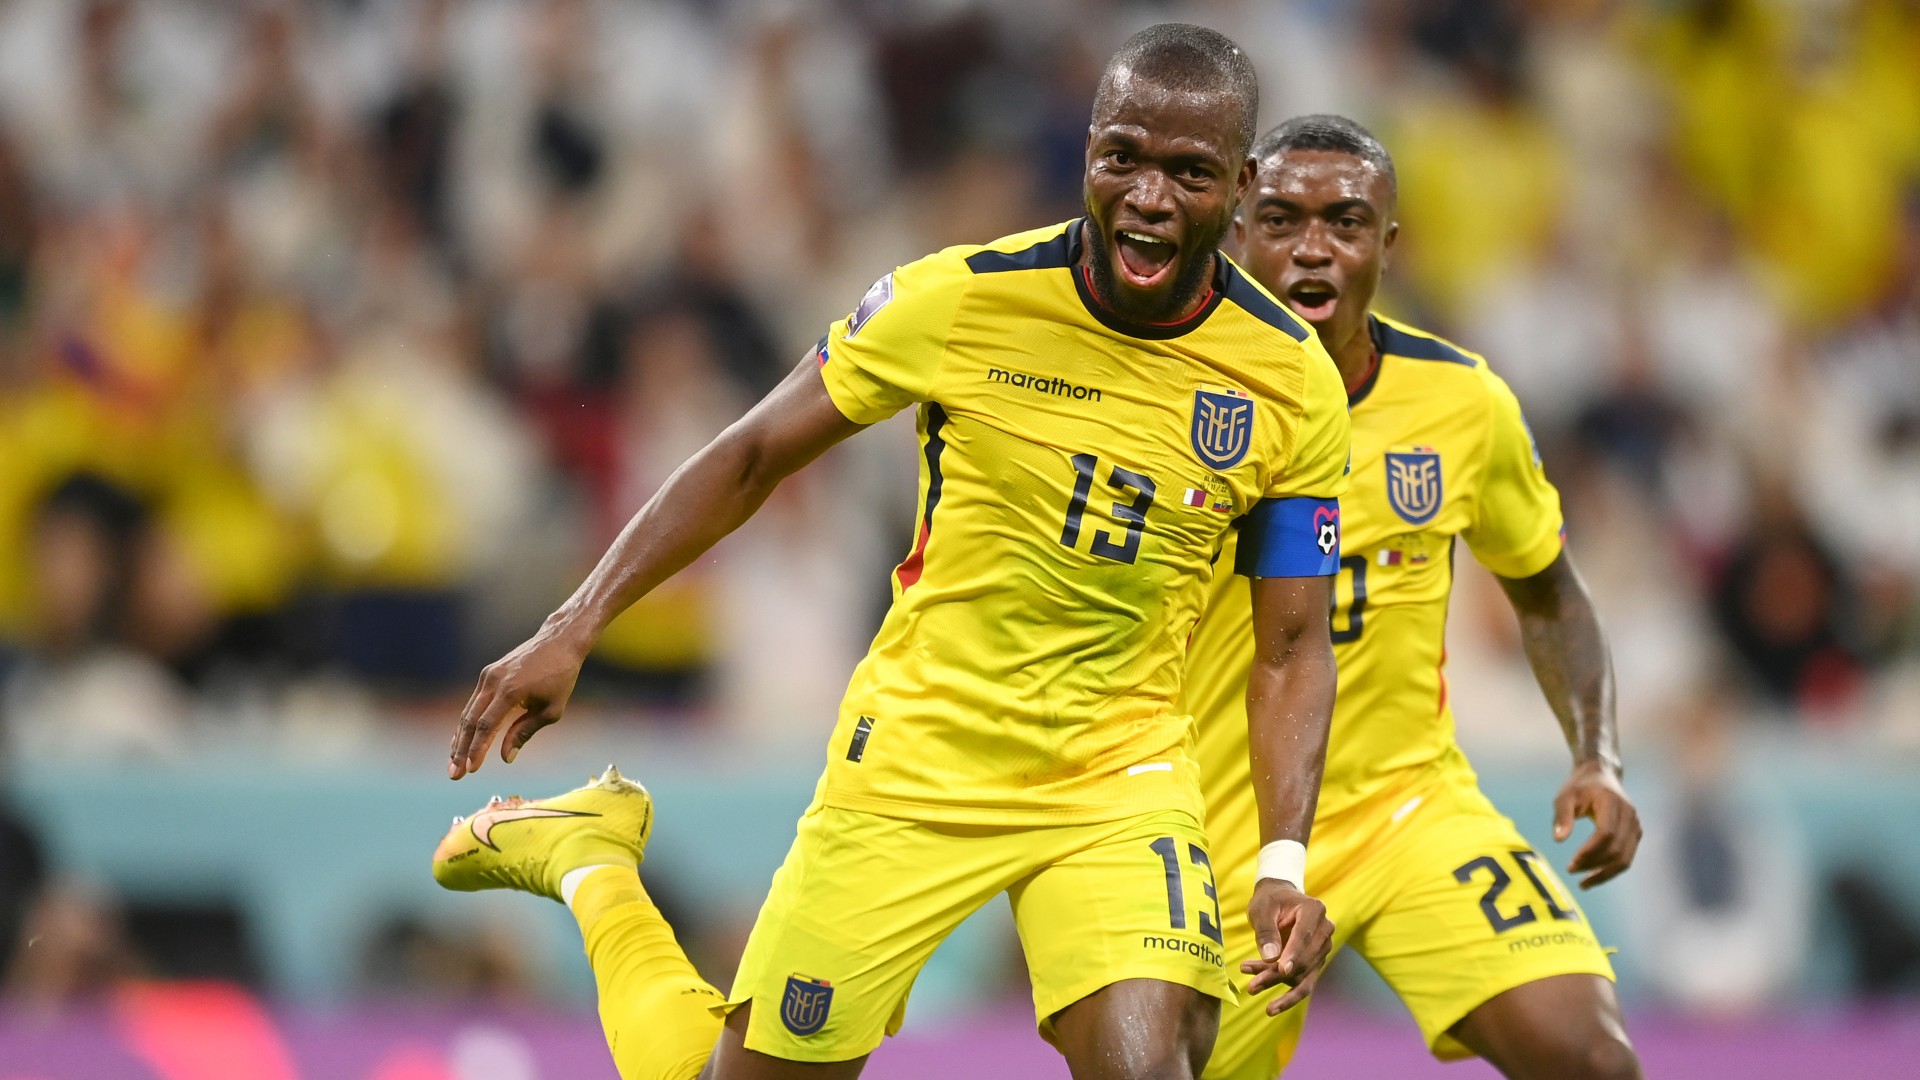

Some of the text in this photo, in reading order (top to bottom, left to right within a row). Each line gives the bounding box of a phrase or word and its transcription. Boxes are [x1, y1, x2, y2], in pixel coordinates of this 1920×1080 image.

[988, 369, 1101, 401] marathon
[1060, 453, 1156, 564] 13
[1149, 837, 1223, 947] 13
[1453, 851, 1581, 934] 20
[1144, 936, 1224, 967] maratho
